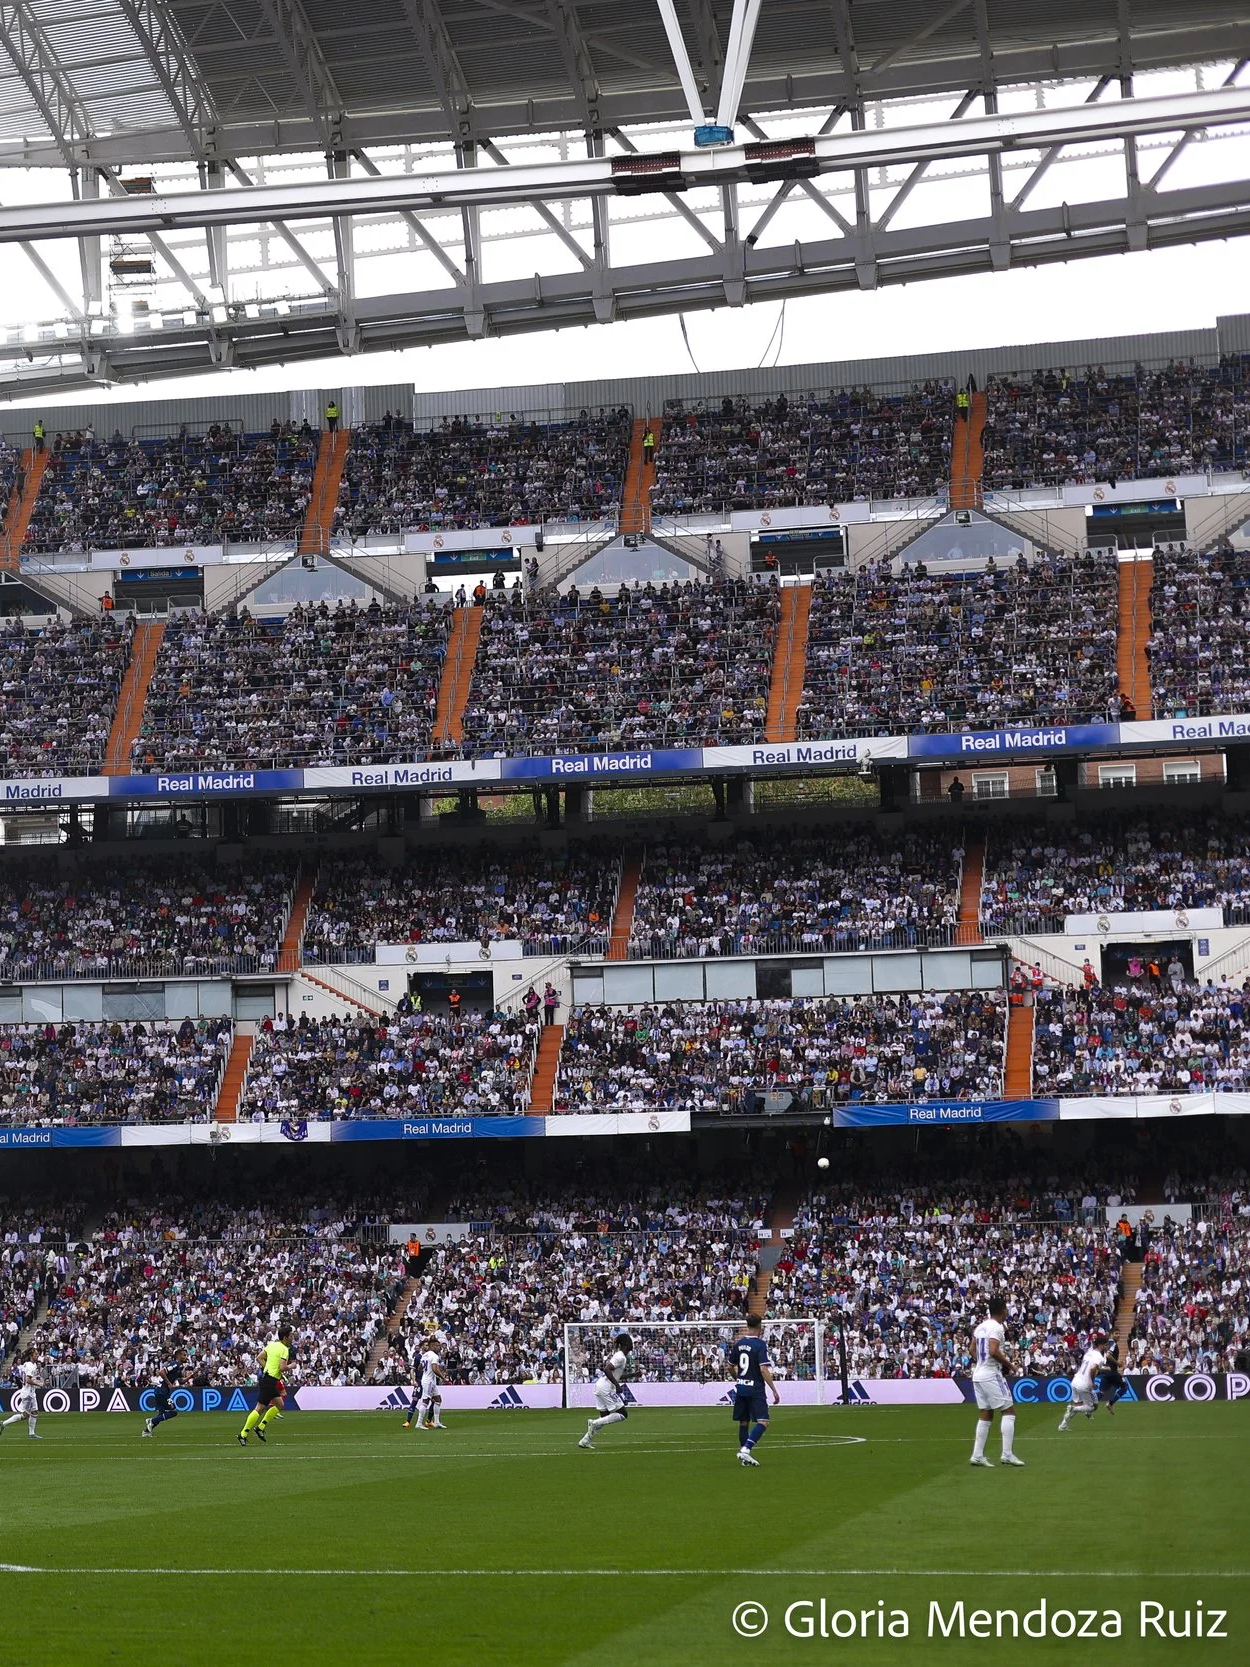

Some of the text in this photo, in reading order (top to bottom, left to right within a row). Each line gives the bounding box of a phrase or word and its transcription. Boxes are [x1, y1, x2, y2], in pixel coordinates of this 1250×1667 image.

[961, 729, 1067, 751] Real Madrid
[1172, 723, 1213, 739] Real
[552, 753, 652, 774] Real Madrid
[753, 744, 857, 764] Real Madrid
[158, 773, 255, 792] Real Madrid
[352, 767, 452, 786] Real Madrid
[6, 784, 62, 800] Madrid
[910, 1106, 982, 1120] Real Madrid
[12, 1132, 51, 1144] Madrid
[403, 1122, 472, 1135] Real Madrid
[739, 1353, 750, 1377] 9
[10, 1388, 132, 1412] COPA
[139, 1387, 250, 1412] COPA
[1013, 1377, 1138, 1403] CO
